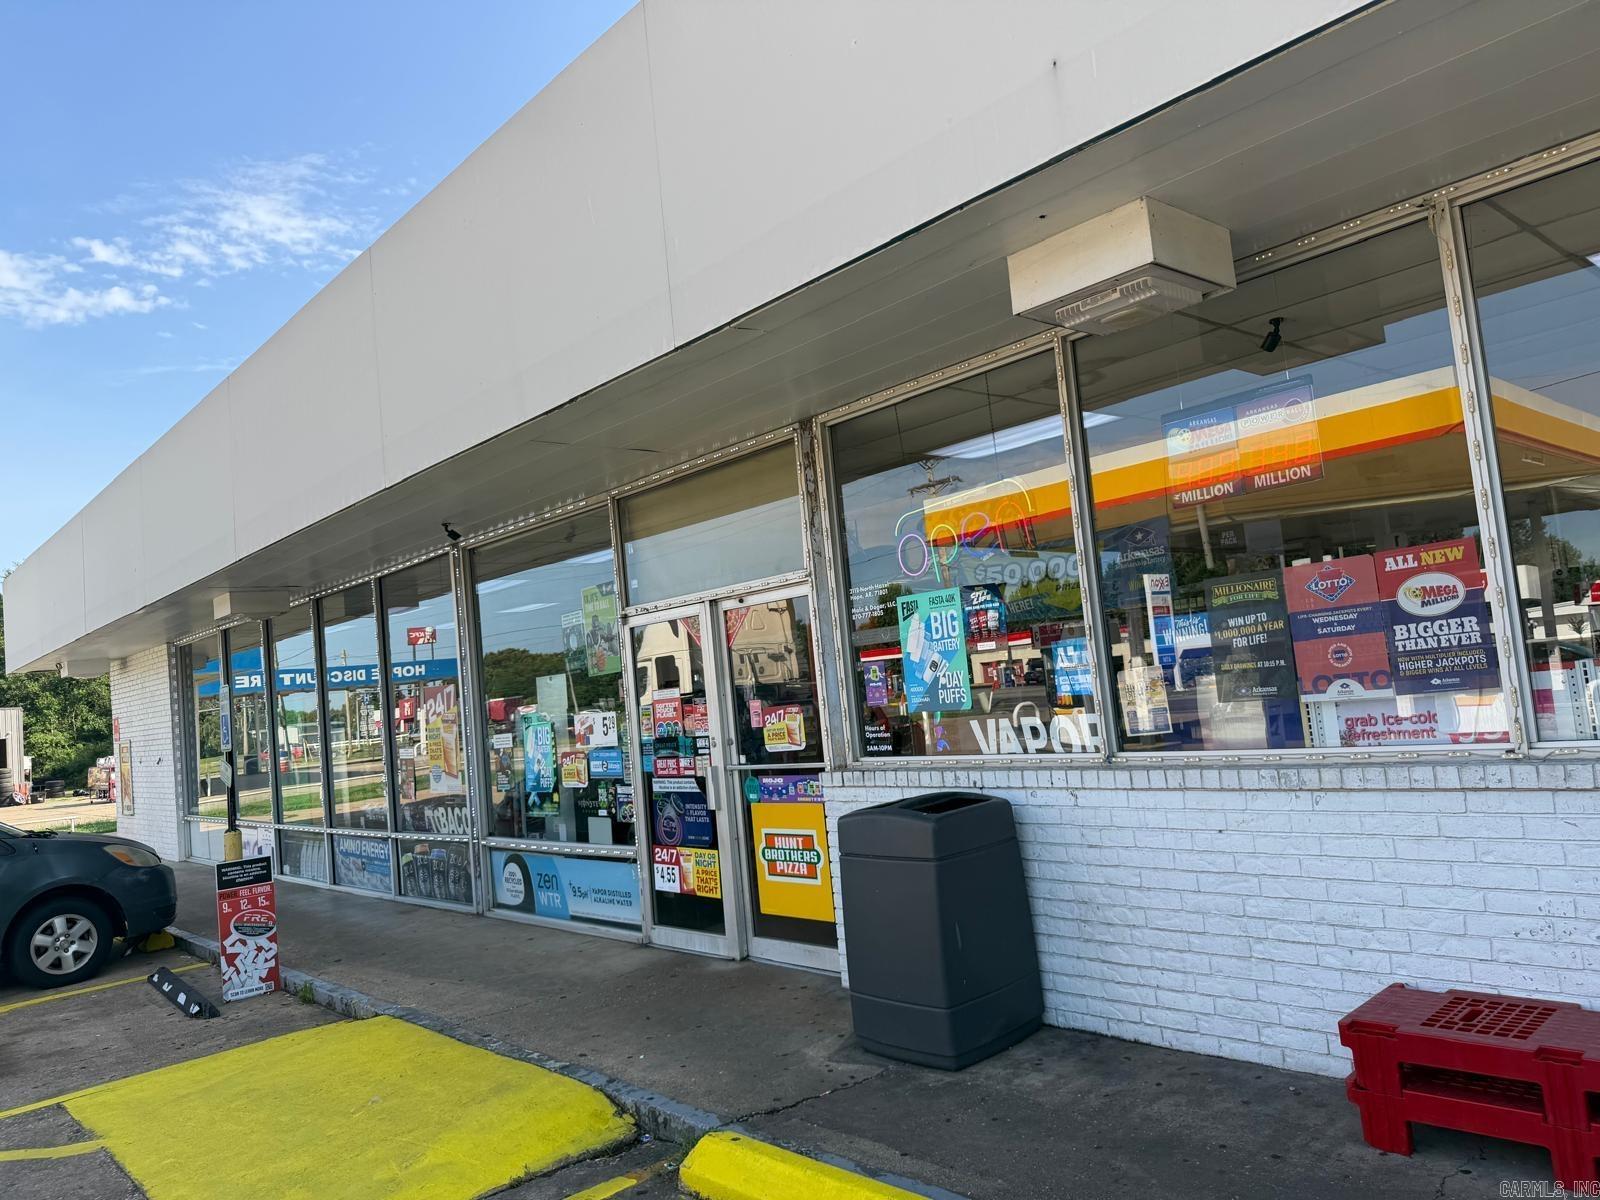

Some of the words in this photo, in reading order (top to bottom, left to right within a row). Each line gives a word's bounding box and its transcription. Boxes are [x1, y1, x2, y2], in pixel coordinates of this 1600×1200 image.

[1246, 403, 1279, 415] ARKANSAS
[1189, 417, 1217, 427] ARKANSAS
[1254, 465, 1312, 488] MILLION
[1182, 482, 1234, 503] MILLION
[1116, 545, 1165, 562] Arkansas
[1385, 554, 1418, 572] ALL
[1420, 546, 1464, 565] NEW
[1213, 579, 1276, 598] MILLIONAIRE
[1312, 578, 1347, 590] LOTTO
[1421, 584, 1458, 599] MEGA
[929, 596, 944, 606] FASTA
[945, 593, 956, 603] 40K
[1230, 594, 1243, 602] FOR
[1421, 594, 1459, 608] MILLIONS
[901, 600, 919, 617] FASTA
[931, 609, 960, 640] BIG
[1228, 617, 1244, 628] WIN
[1245, 615, 1256, 625] UP
[1257, 612, 1267, 622] TO
[1263, 620, 1284, 632] YEAR
[1312, 613, 1358, 624] WEDNESDAY
[1163, 619, 1208, 646] WINNING!
[1317, 624, 1356, 634] SATURDAY
[1393, 616, 1480, 640] BIGGER
[933, 638, 961, 652] BATTERY
[1233, 638, 1248, 648] FOR
[1249, 633, 1267, 645] LIFE!
[1395, 636, 1438, 651] THAN
[1439, 631, 1482, 647] EVER
[1399, 660, 1433, 671] HIGHER
[1435, 654, 1487, 668] JACKPOTS
[1425, 651, 1456, 660] MULTIPLIER
[1465, 663, 1488, 671] LEVELS
[939, 688, 967, 704] PUFFS
[764, 710, 784, 726] 24/7
[1344, 714, 1378, 730] grab
[969, 713, 1101, 754] VAPOR
[339, 838, 361, 854] AMINO
[361, 840, 389, 860] ENERGY
[774, 836, 804, 849] HUNT
[655, 848, 677, 863] 24/7
[764, 849, 818, 863] BROTHERS
[695, 860, 716, 869] NIGHT
[776, 861, 808, 875] PIZZA
[537, 873, 559, 891] zen
[696, 877, 718, 886] THAT'S
[607, 890, 632, 898] DISTILLED
[697, 885, 719, 895] RIGHT
[538, 891, 562, 908] WTR
[616, 898, 633, 907] WATER
[243, 914, 270, 922] FRE
